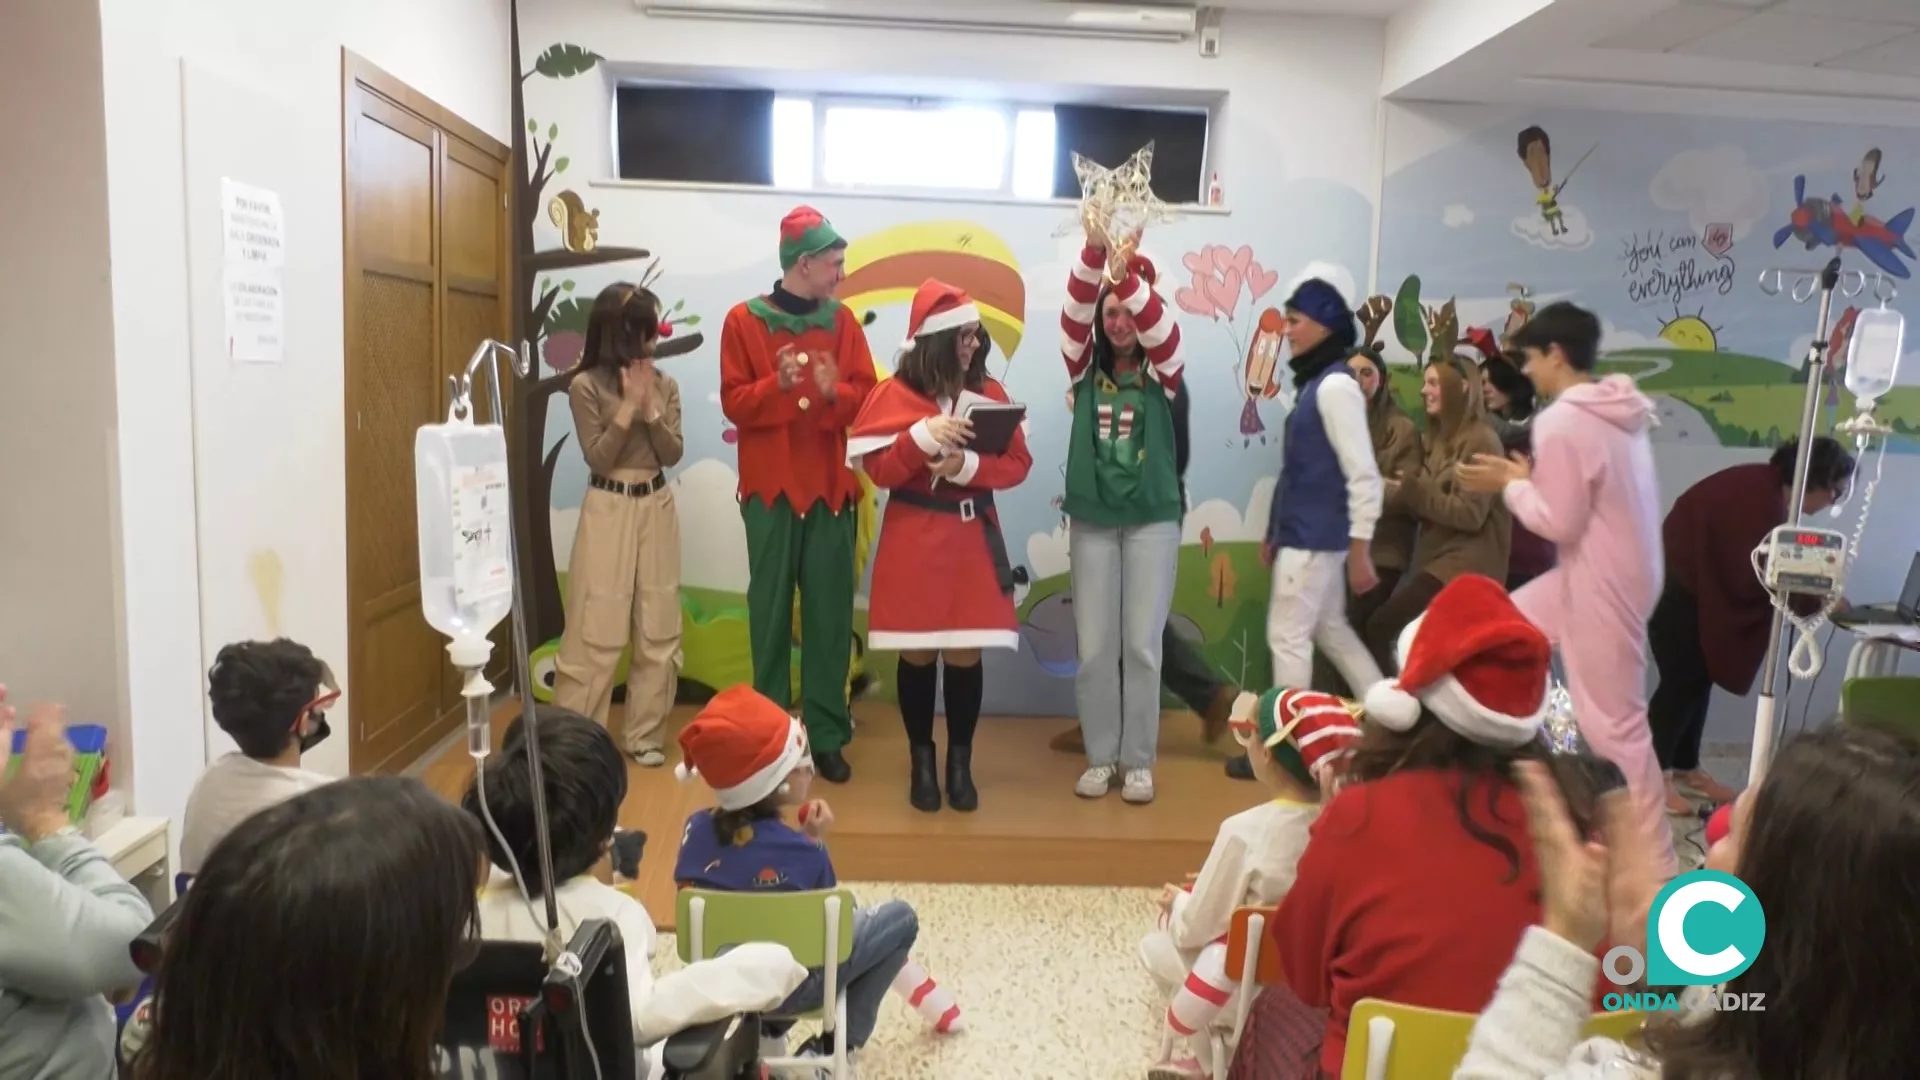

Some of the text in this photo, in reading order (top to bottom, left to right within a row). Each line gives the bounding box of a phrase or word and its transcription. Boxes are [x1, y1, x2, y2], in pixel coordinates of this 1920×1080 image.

[1669, 235, 1696, 252] can
[1629, 256, 1735, 303] everything
[491, 997, 531, 1016] OR
